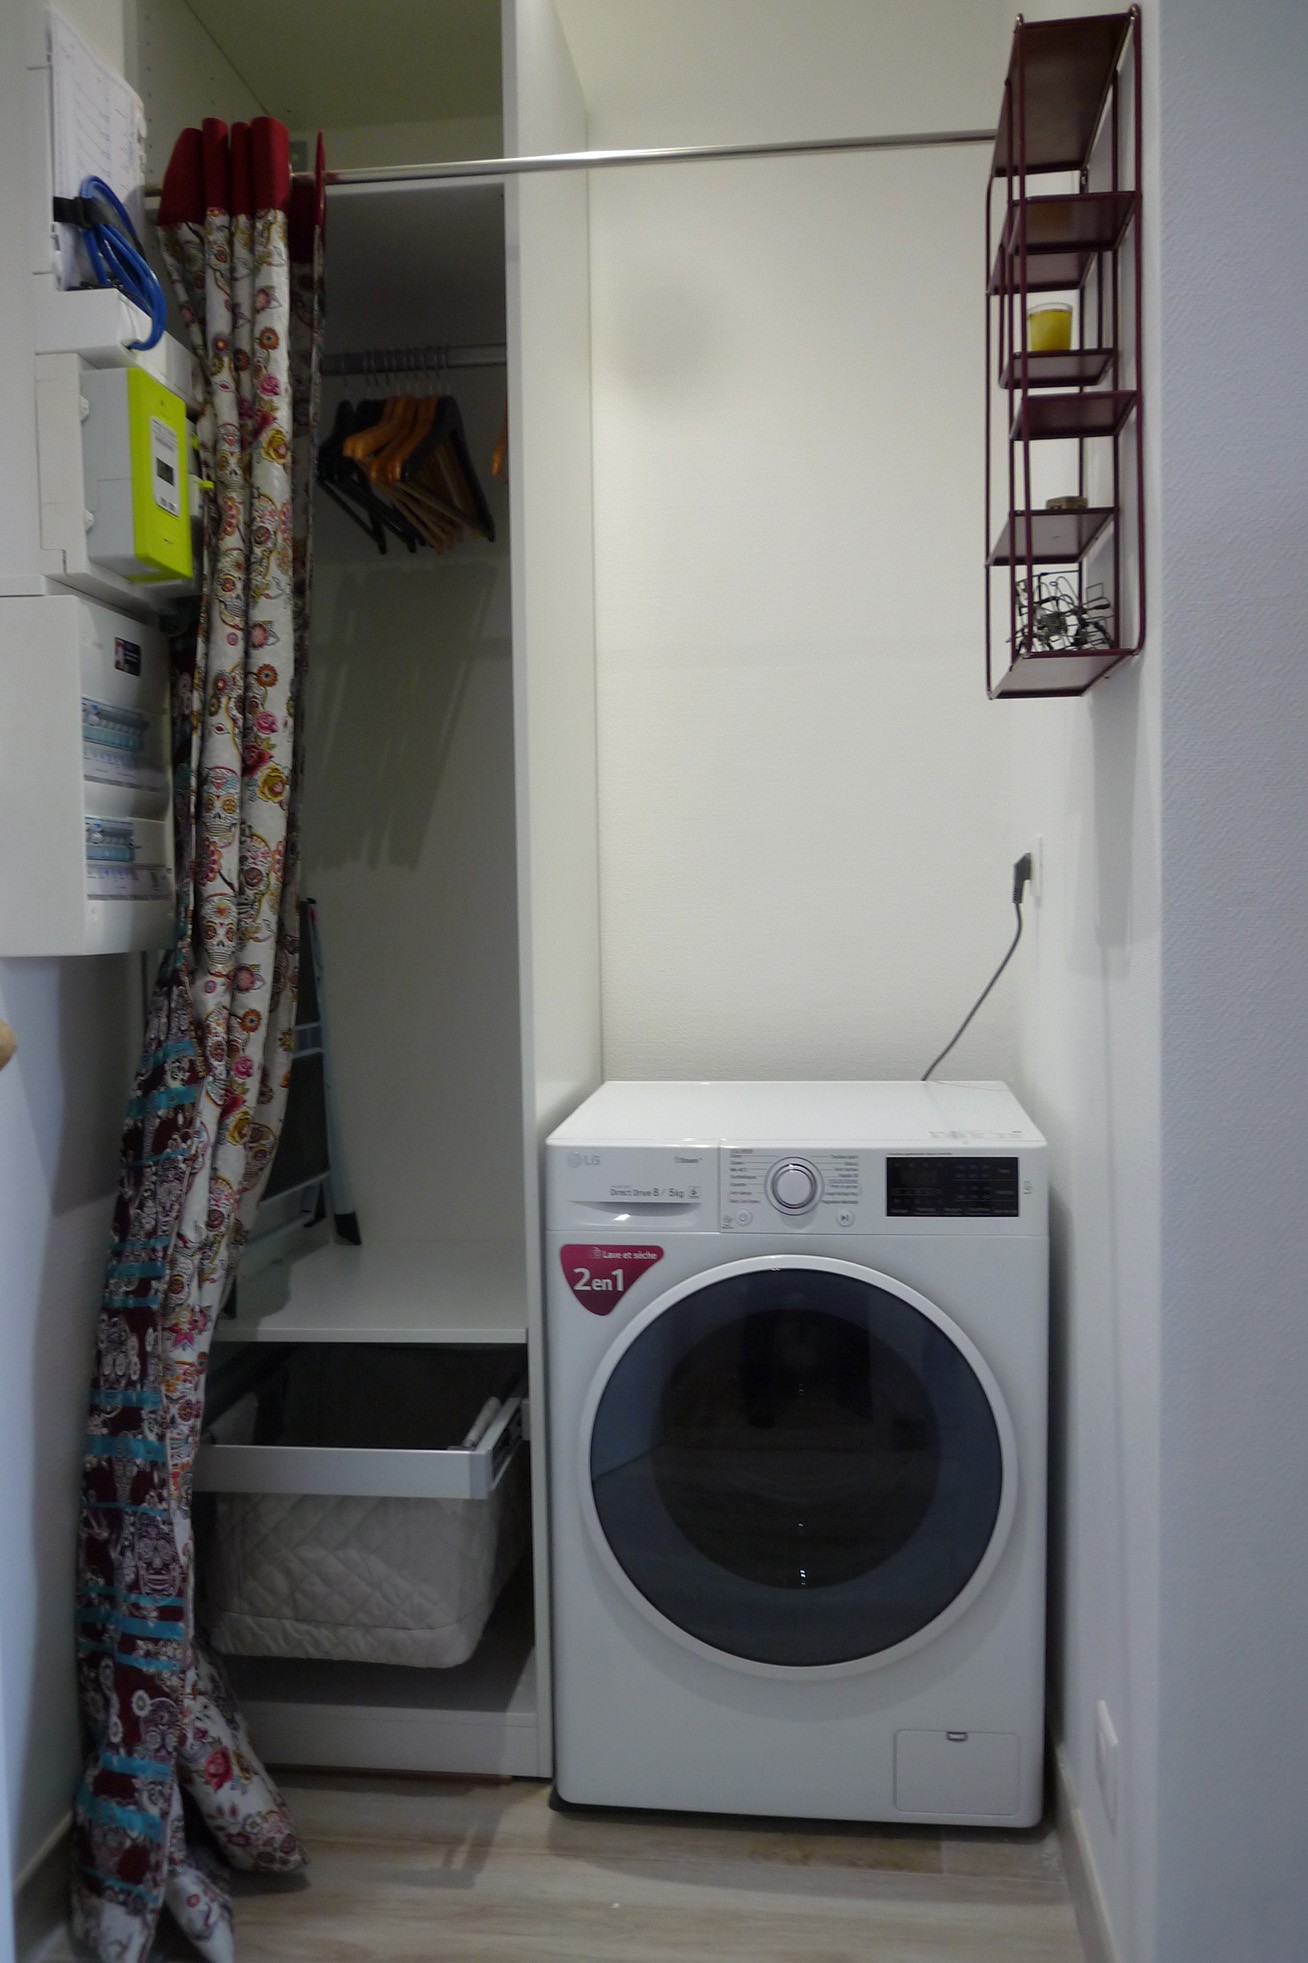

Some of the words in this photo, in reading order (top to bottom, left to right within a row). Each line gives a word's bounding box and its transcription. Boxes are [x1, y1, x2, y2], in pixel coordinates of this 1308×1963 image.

[584, 1154, 601, 1166] LG
[610, 1188, 632, 1197] Direct
[633, 1188, 652, 1197] Drive
[652, 1187, 660, 1197] 8
[668, 1187, 685, 1199] 5kg
[602, 1250, 622, 1260] Lave
[622, 1251, 632, 1260] et
[633, 1250, 658, 1260] sèche
